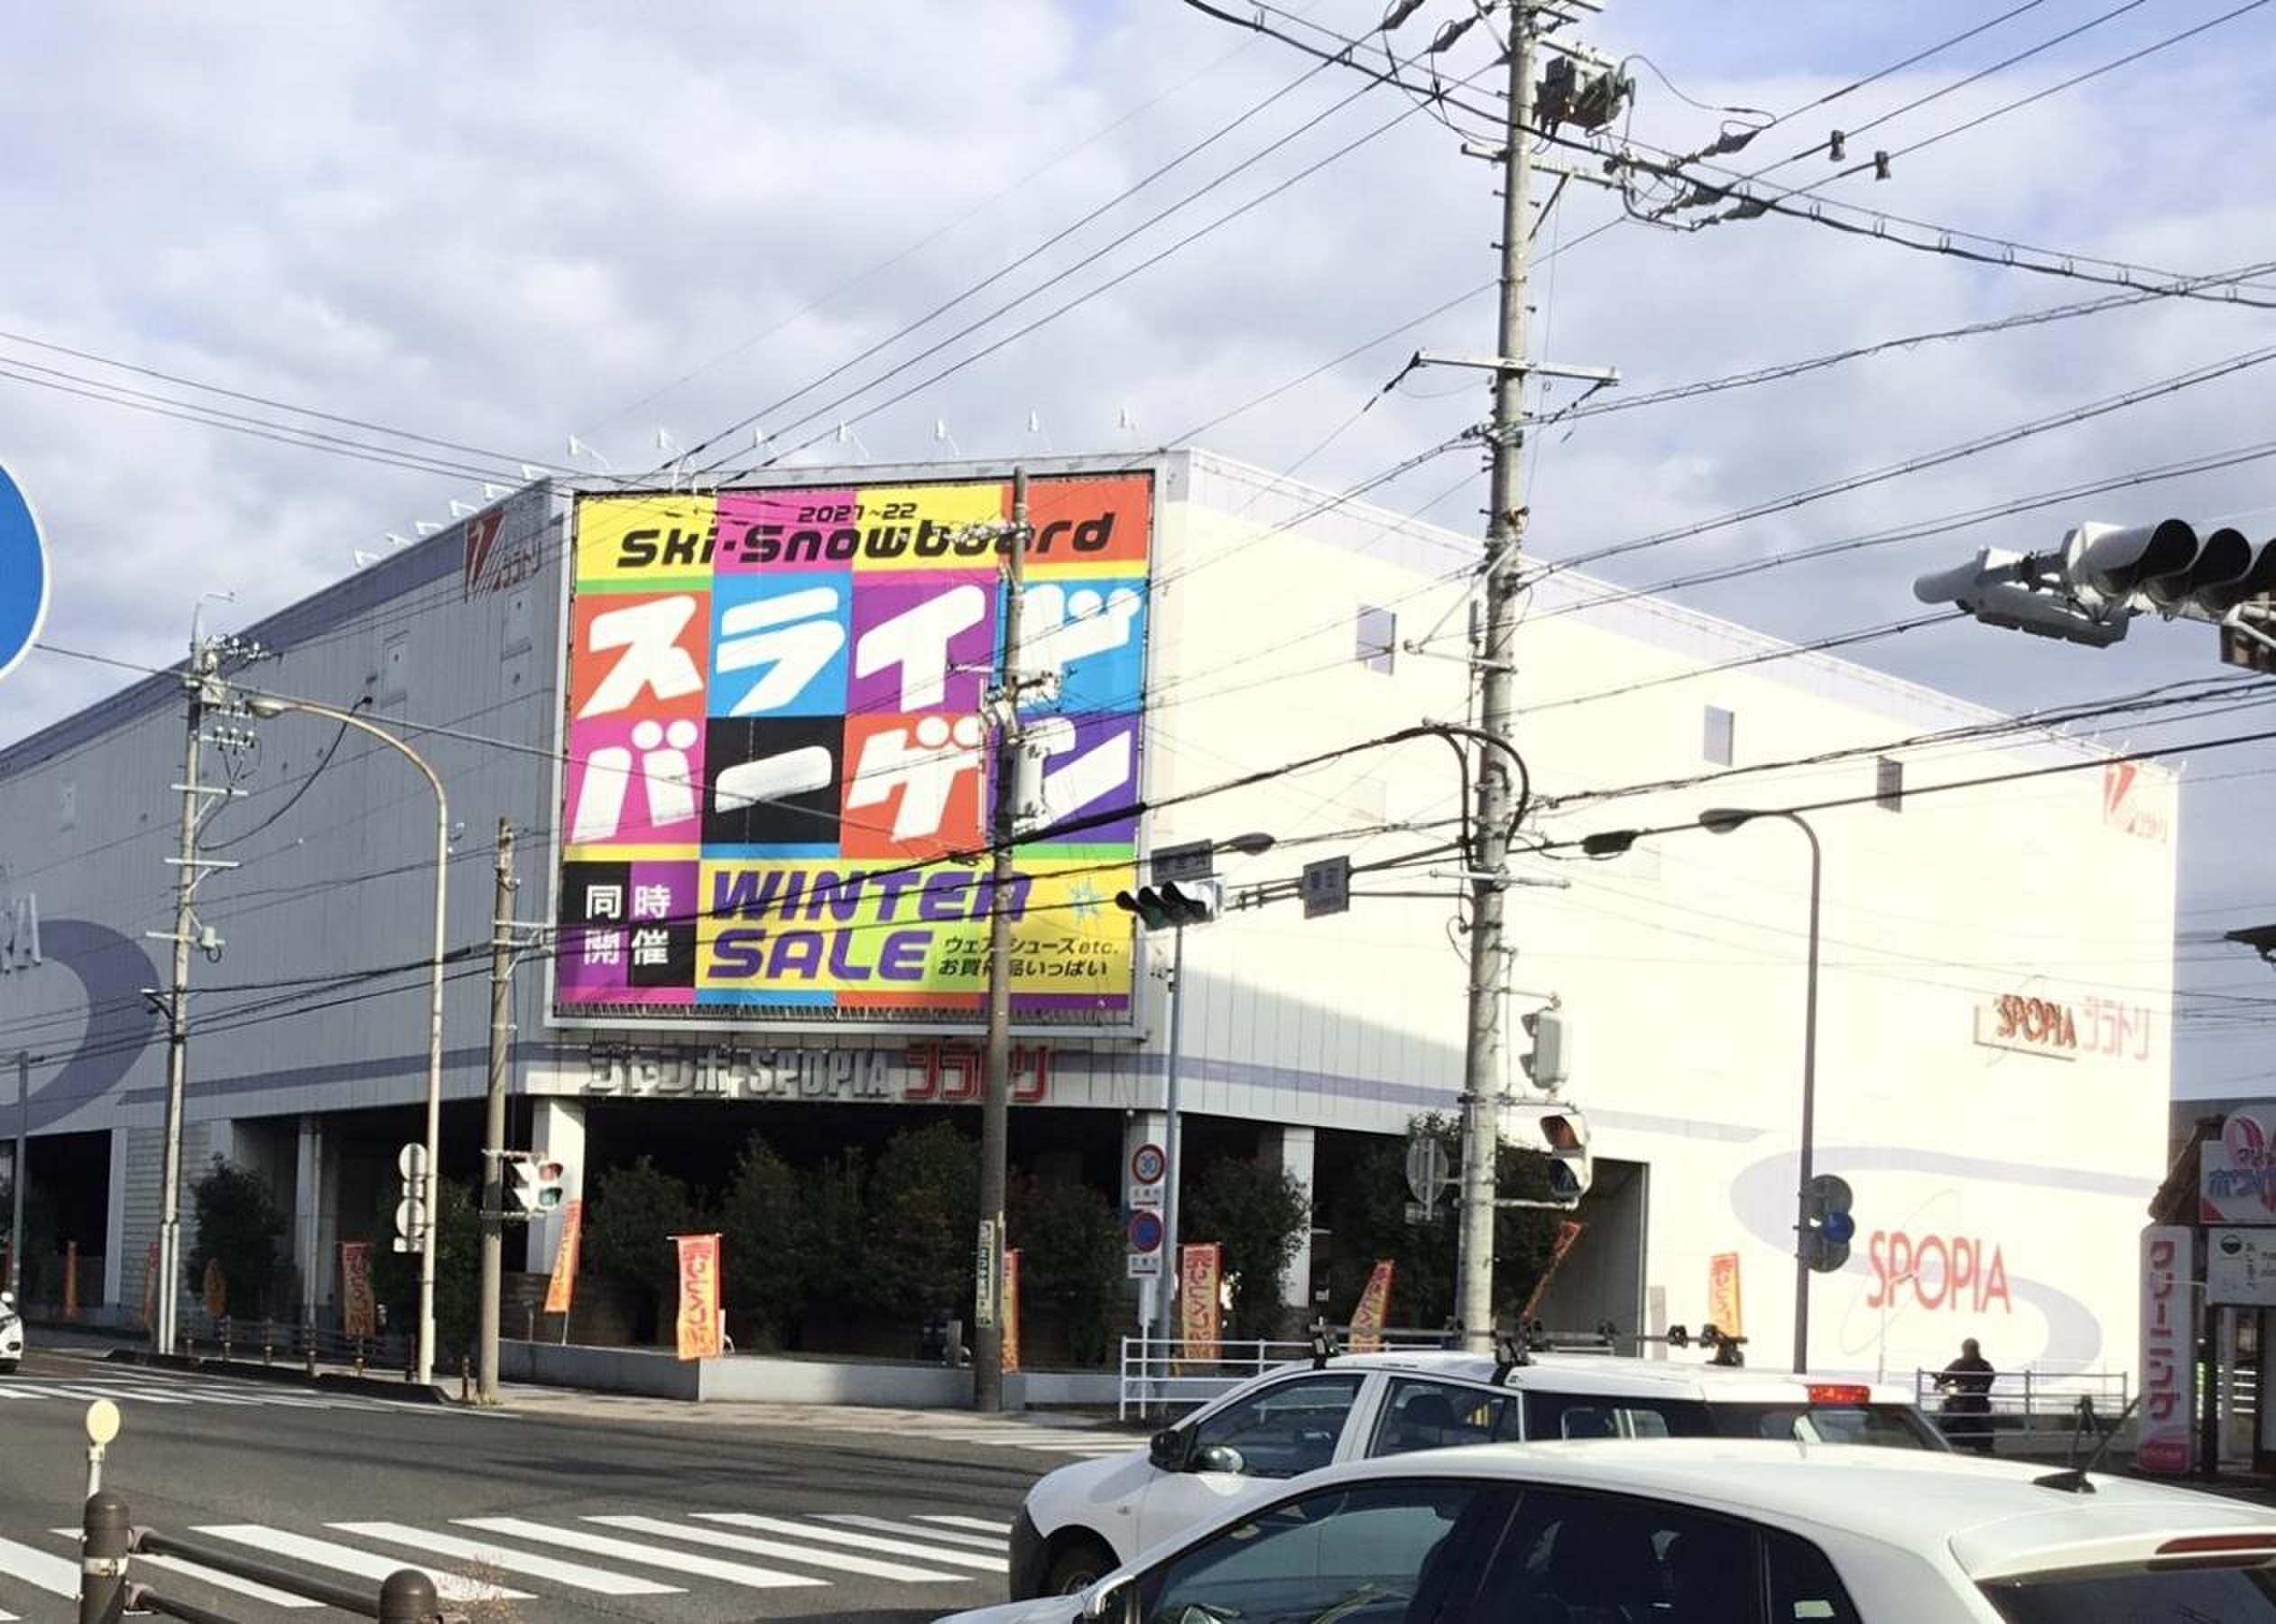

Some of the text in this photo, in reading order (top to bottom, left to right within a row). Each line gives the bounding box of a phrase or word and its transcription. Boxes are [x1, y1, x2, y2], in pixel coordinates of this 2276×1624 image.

[578, 584, 1142, 720] スライド
[570, 715, 1132, 843] バーゲン
[586, 884, 671, 918] 同時
[710, 870, 1032, 923] WINTER
[584, 928, 670, 965] 開催
[708, 928, 934, 981] SALE
[749, 1047, 891, 1097] SPOPIA
[1866, 1229, 2012, 1314] SPOPIA
[2149, 1241, 2180, 1421] クリーニング
